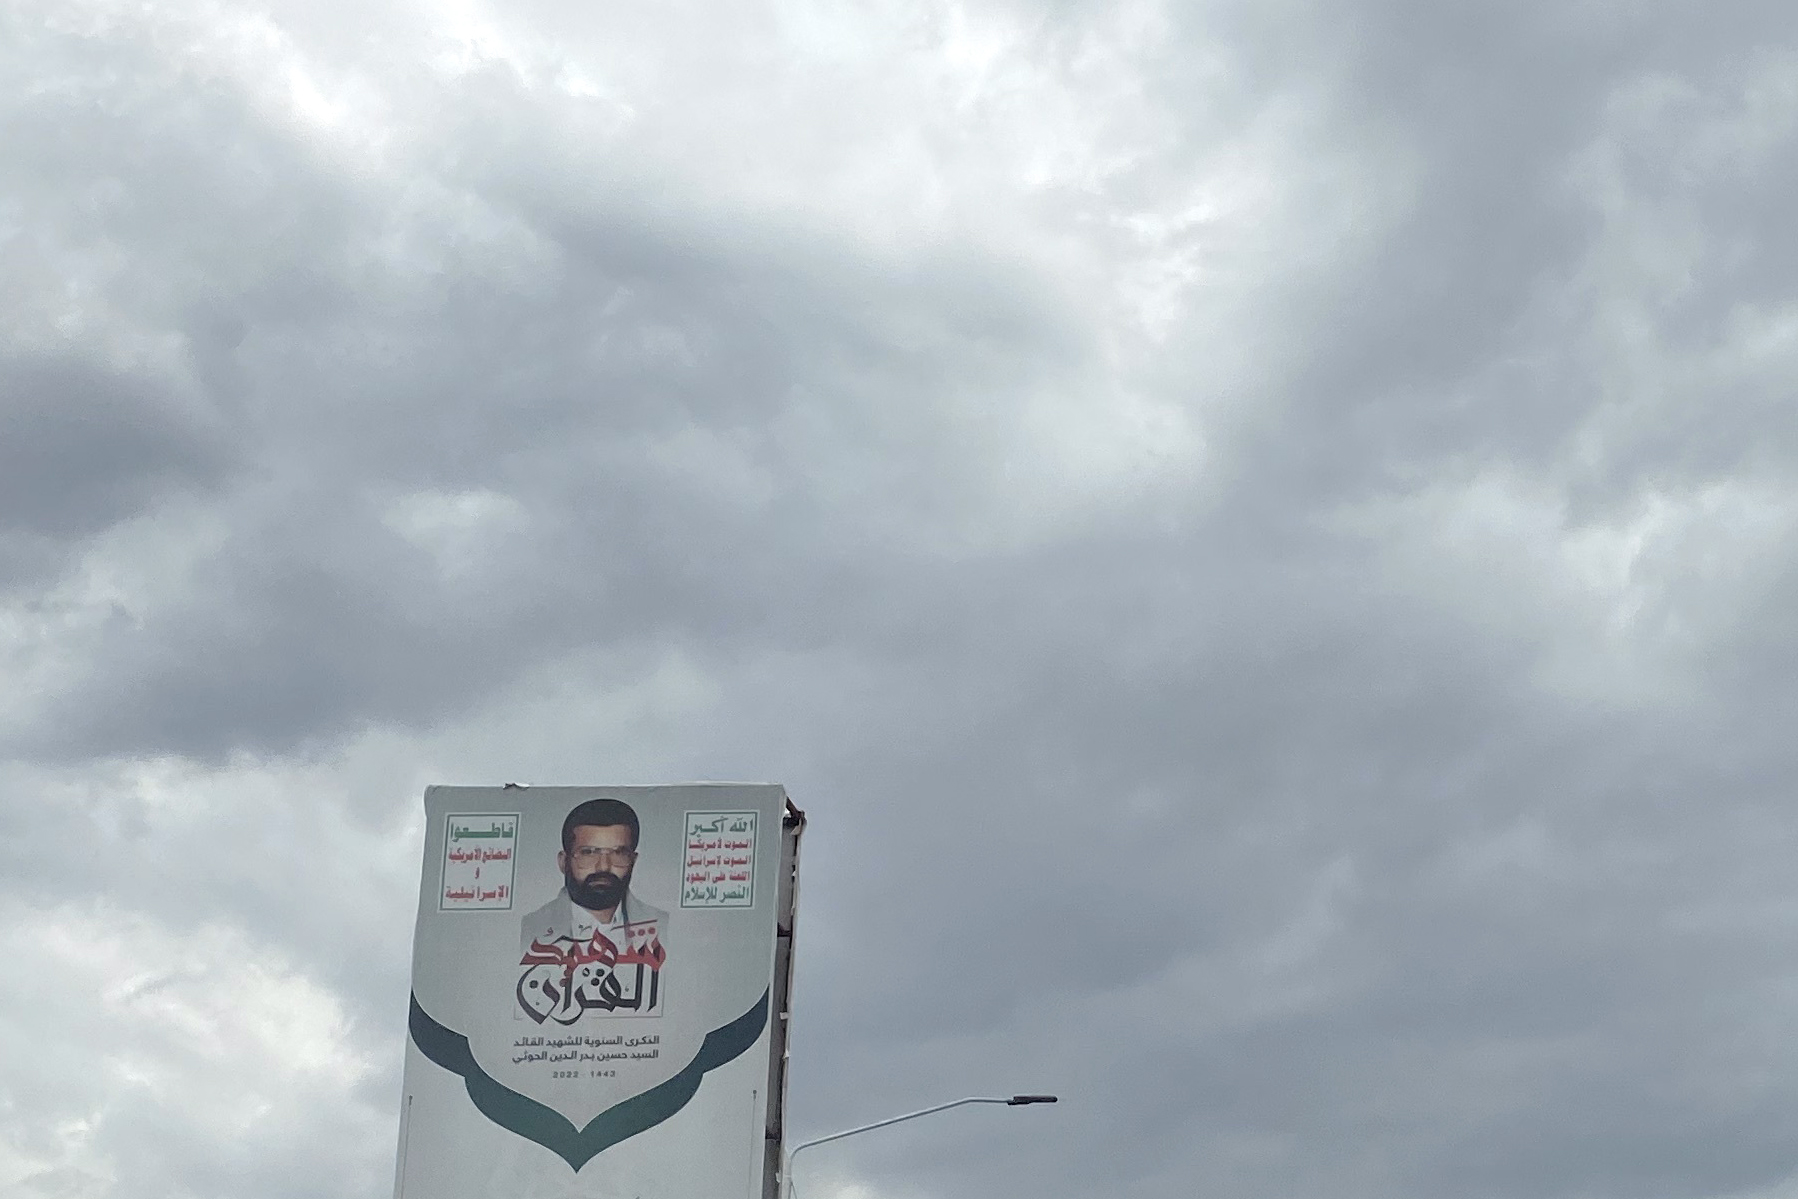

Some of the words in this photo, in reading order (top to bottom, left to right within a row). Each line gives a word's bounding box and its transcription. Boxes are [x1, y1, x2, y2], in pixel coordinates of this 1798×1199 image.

[688, 816, 729, 838] أكبر
[546, 1035, 583, 1048] للشهيد
[584, 1036, 623, 1048] السنوية
[625, 1035, 660, 1047] الذكرى
[511, 1050, 548, 1064] الحوثي
[549, 1050, 578, 1062] الدين
[579, 1053, 595, 1062] بدر
[596, 1052, 628, 1062] حسين
[629, 1049, 659, 1059] السيد
[590, 1070, 616, 1078] 1443
